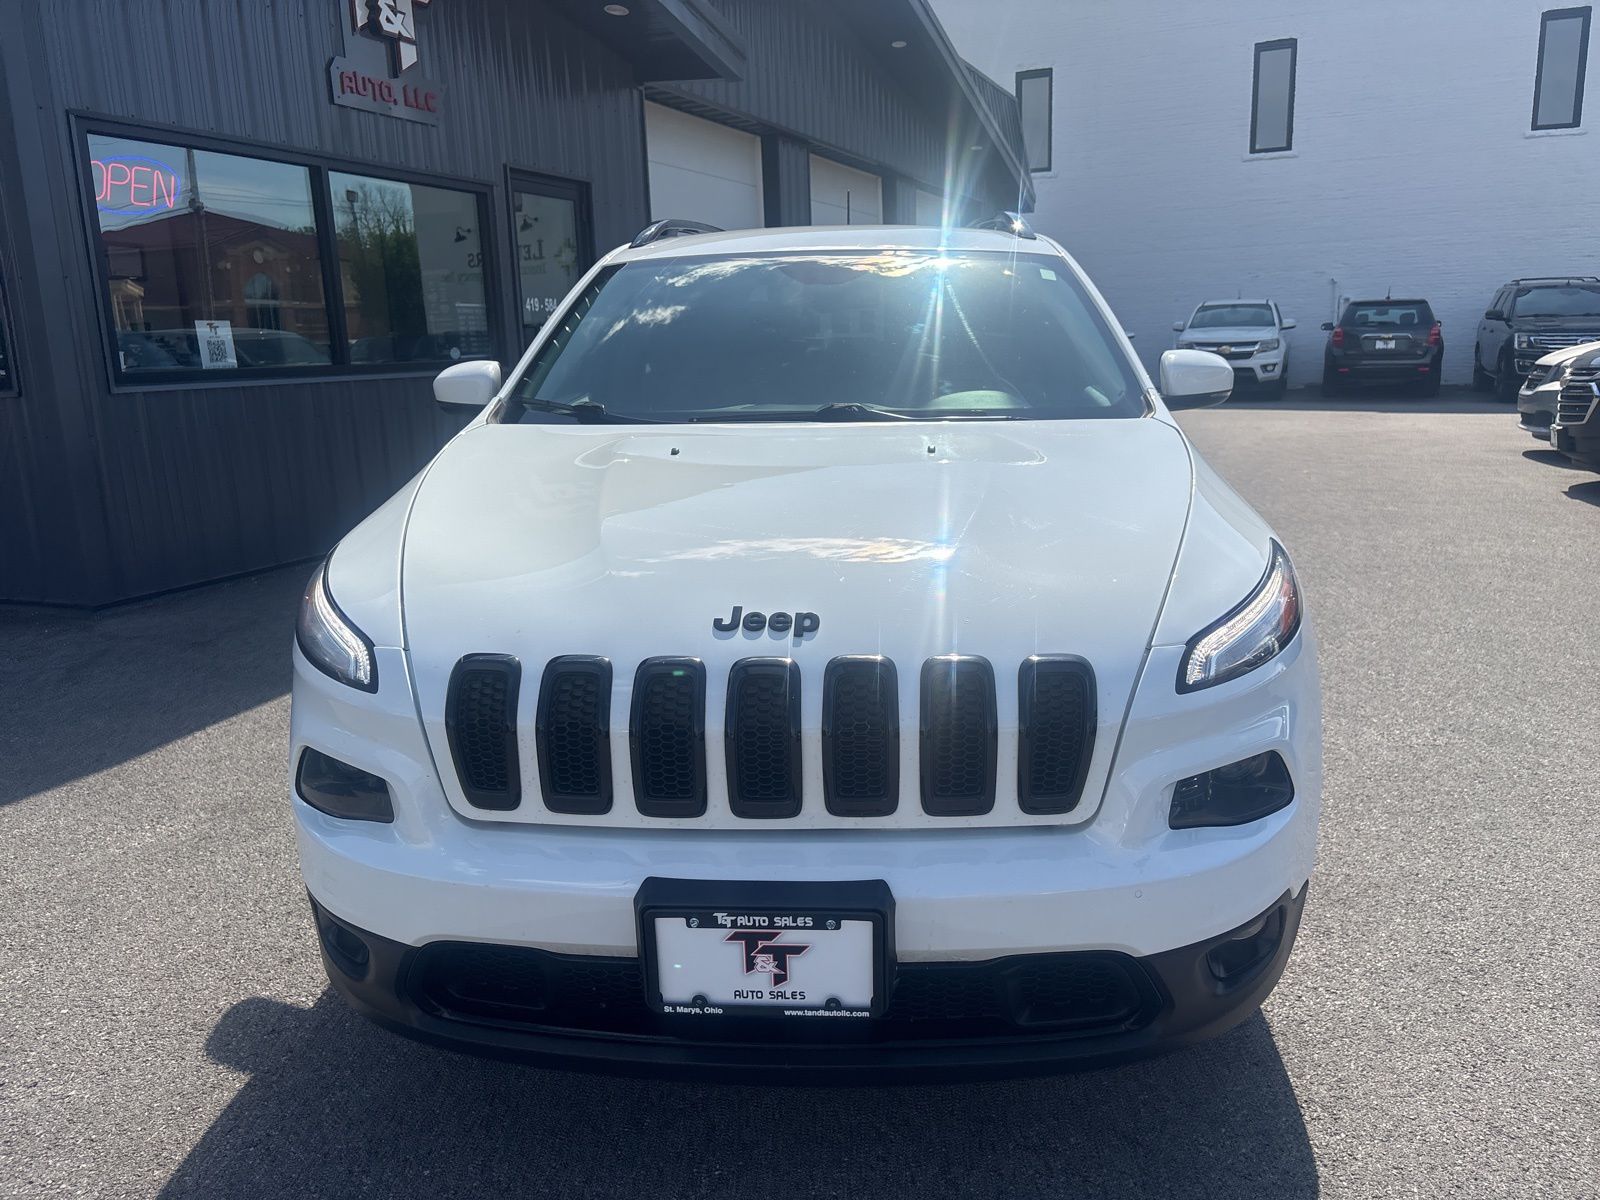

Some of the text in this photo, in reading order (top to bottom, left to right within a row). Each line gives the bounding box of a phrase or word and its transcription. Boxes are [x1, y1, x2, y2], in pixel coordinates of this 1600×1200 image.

[403, 84, 438, 113] LLC
[91, 160, 175, 208] OPEN
[713, 605, 820, 638] Jeep
[737, 914, 769, 927] AUTO
[773, 915, 814, 927] SALES
[723, 929, 813, 988] T&T
[733, 989, 806, 1001] AUTO SALES
[663, 1005, 724, 1015] St. Marys, Ohio
